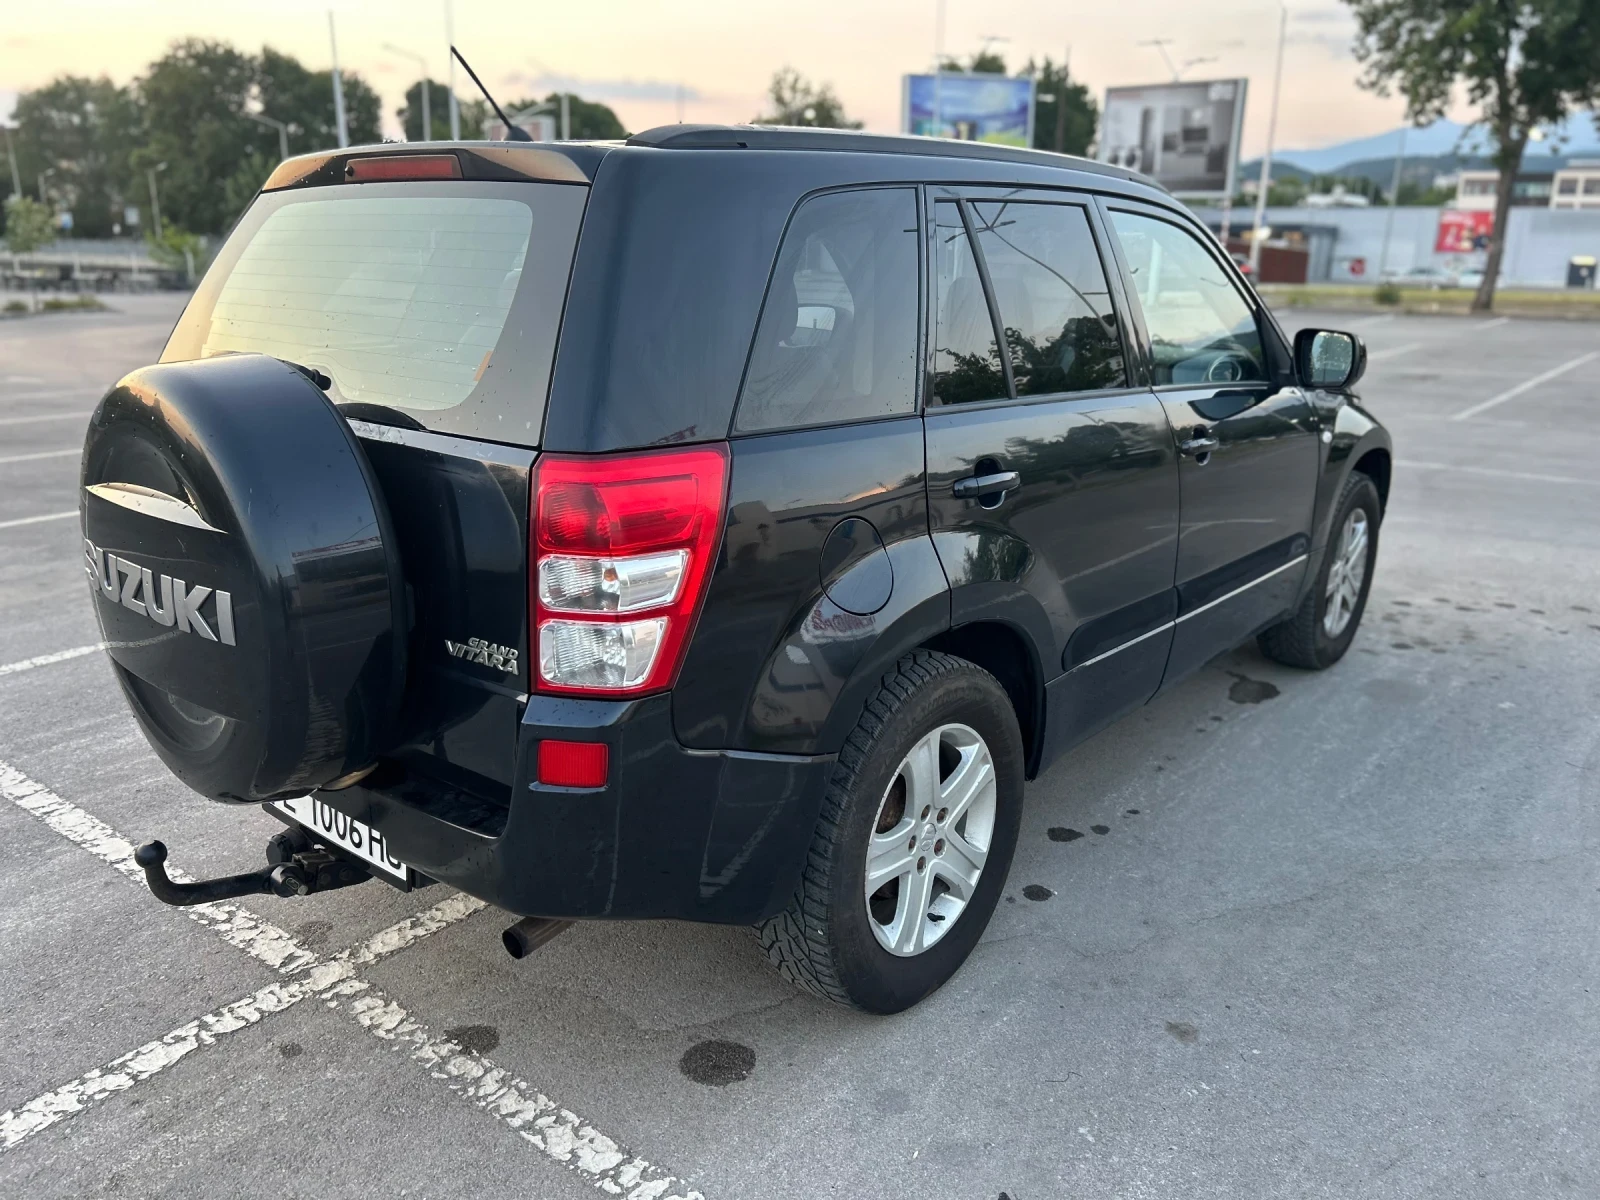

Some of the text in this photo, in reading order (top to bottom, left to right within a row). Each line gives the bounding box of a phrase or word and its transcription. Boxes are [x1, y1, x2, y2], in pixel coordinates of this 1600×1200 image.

[84, 538, 236, 646] SUZUKI
[444, 639, 519, 676] VITARA
[468, 636, 519, 660] GRAND
[312, 798, 362, 849] 1006
